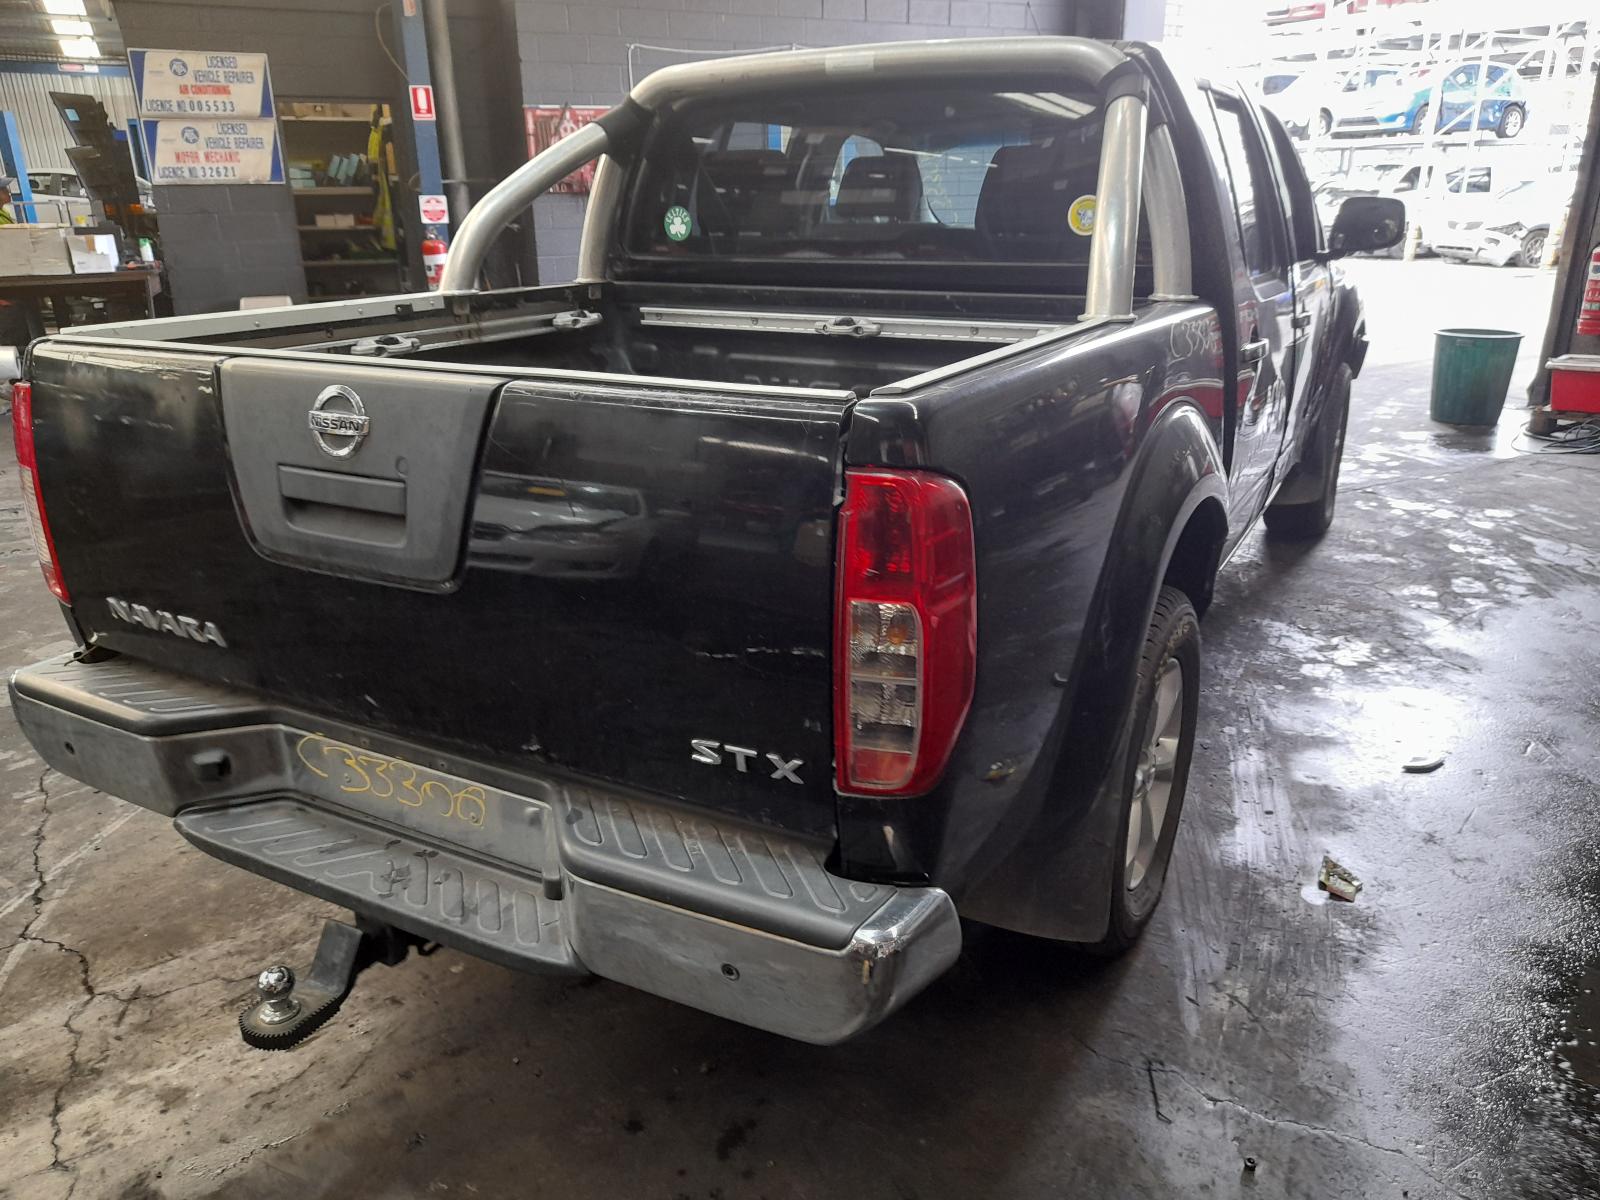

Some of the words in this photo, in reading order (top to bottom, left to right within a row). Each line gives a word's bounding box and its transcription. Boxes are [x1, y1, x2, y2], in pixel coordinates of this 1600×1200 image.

[205, 55, 238, 69] LICENSED
[192, 69, 222, 83] VEHICLE
[223, 70, 256, 84] REPAIRER
[189, 100, 236, 113] 005533
[216, 121, 248, 136] LICENSED
[203, 136, 232, 150] VEHICLE
[232, 136, 265, 150] REPAIRER
[203, 151, 241, 164] MECHANIC
[200, 166, 237, 178] 32621
[665, 208, 690, 223] CELTICS
[311, 414, 360, 431] NISSAN
[106, 596, 228, 649] NAVARA
